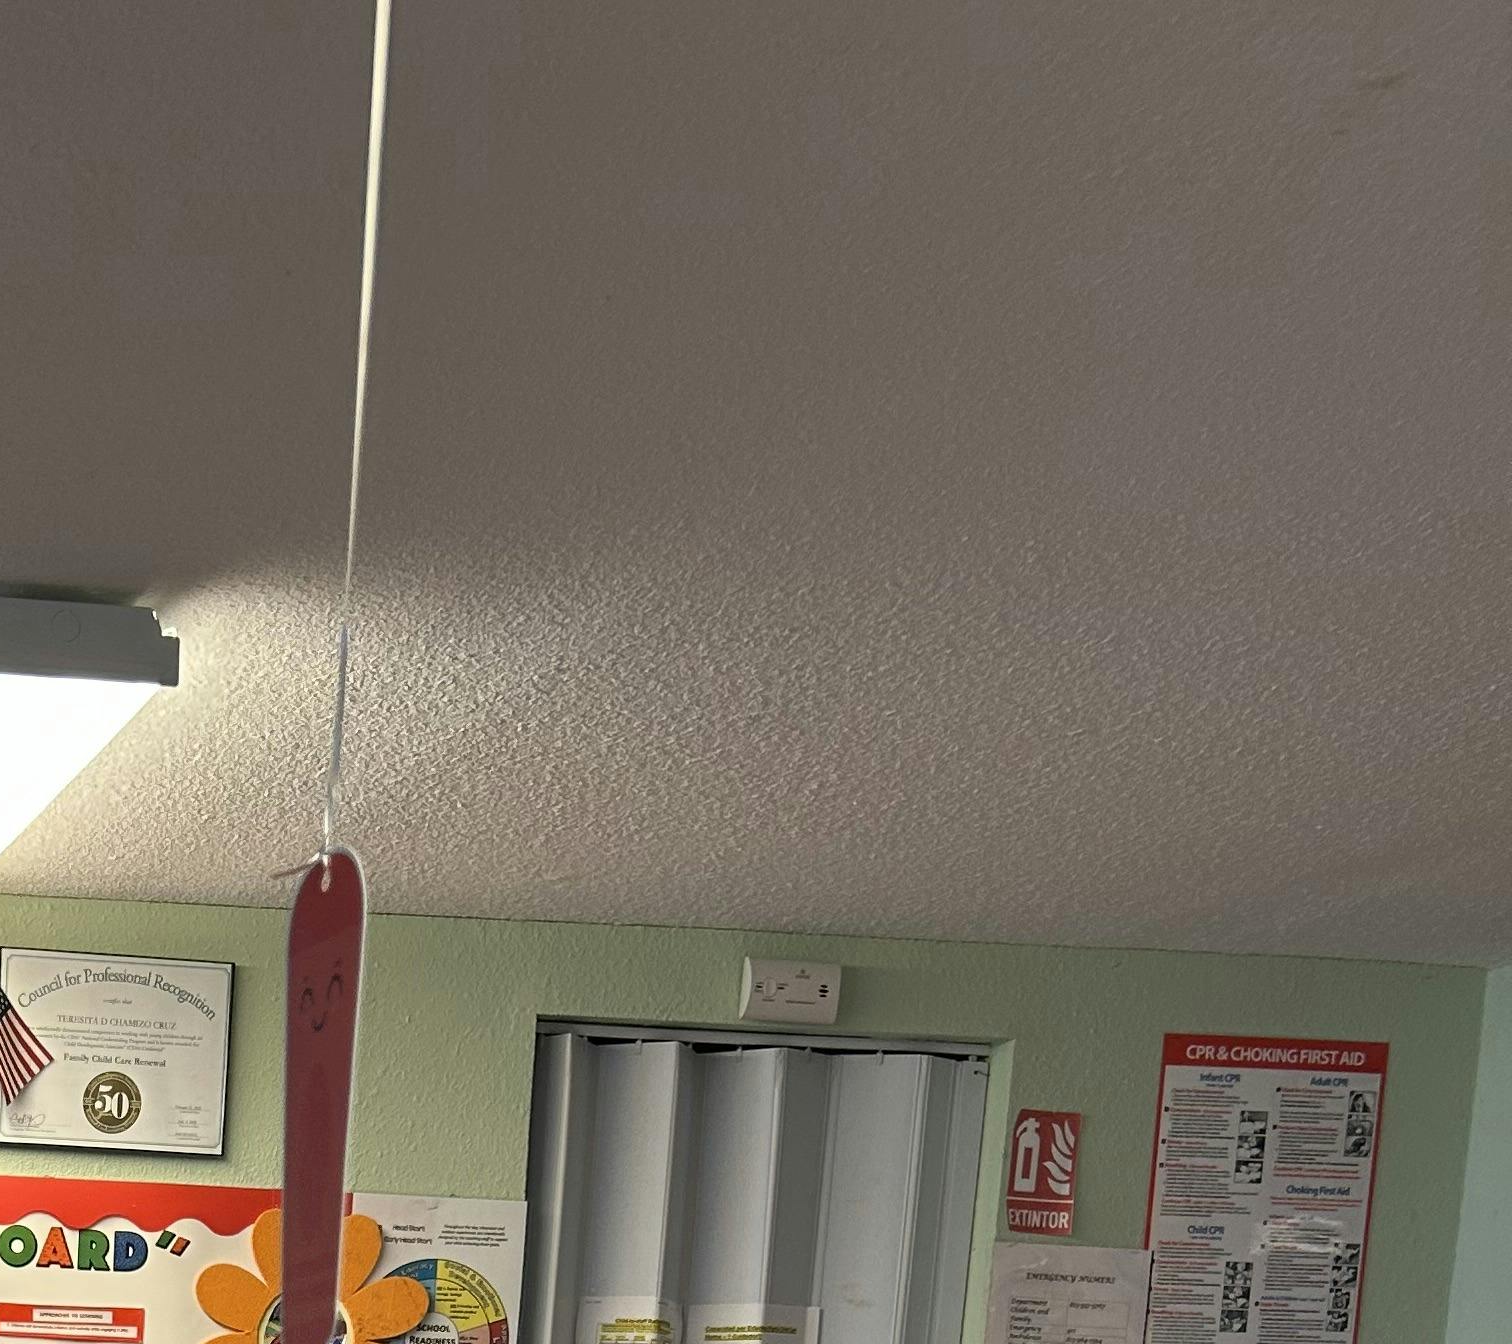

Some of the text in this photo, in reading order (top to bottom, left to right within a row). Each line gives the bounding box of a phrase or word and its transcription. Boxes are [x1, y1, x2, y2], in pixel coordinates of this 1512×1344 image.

[18, 967, 216, 1021] Council for Professional Recognition
[57, 1015, 177, 1030] TERESITA CHAMIZO CRUZ
[63, 1053, 167, 1068] Family Child Care Renewal
[1186, 1045, 1366, 1066] CPR & CHOKING FIRST AID
[1200, 1073, 1241, 1083] Infant CPR
[94, 1084, 130, 1119] 50
[1007, 1208, 1070, 1230] EXTINTOR
[417, 1324, 450, 1333] SCHOOL
